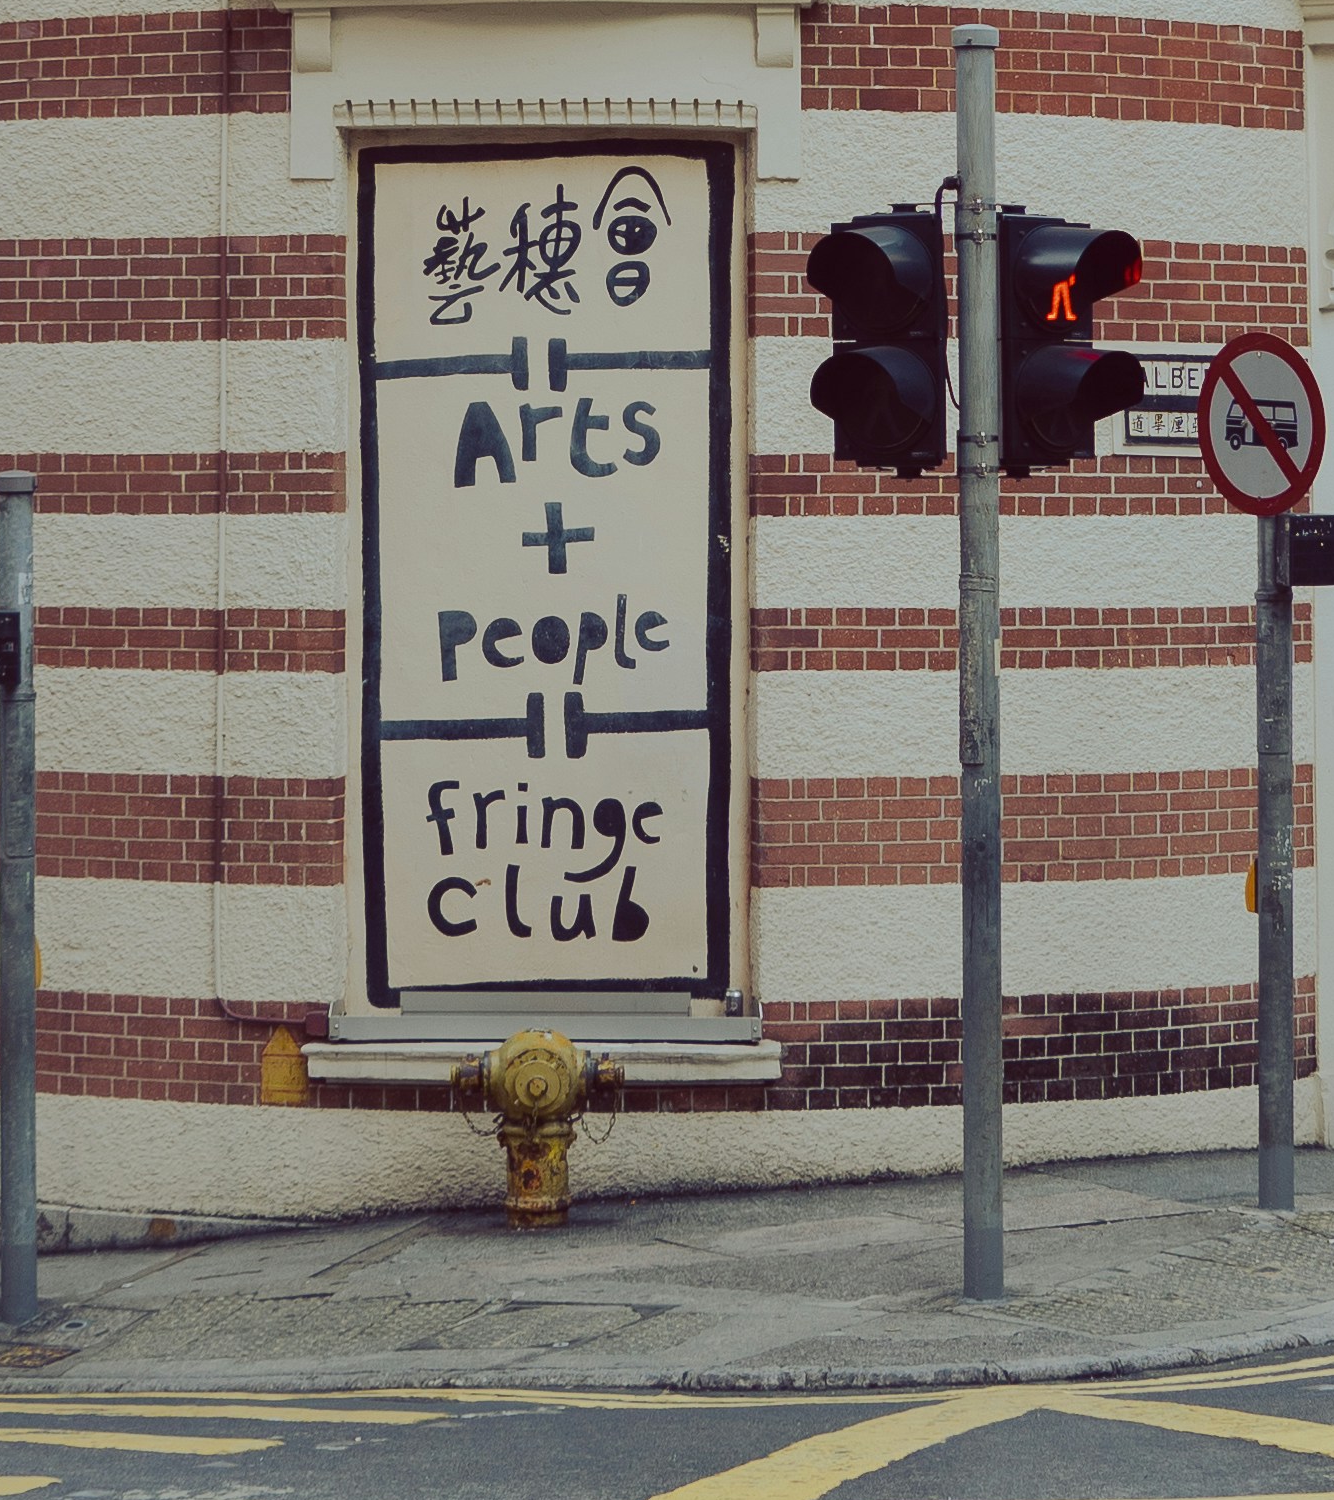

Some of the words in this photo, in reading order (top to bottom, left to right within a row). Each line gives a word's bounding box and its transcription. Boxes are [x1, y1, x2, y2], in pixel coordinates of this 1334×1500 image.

[423, 166, 671, 325] 藝穗會
[454, 398, 660, 488] Arts
